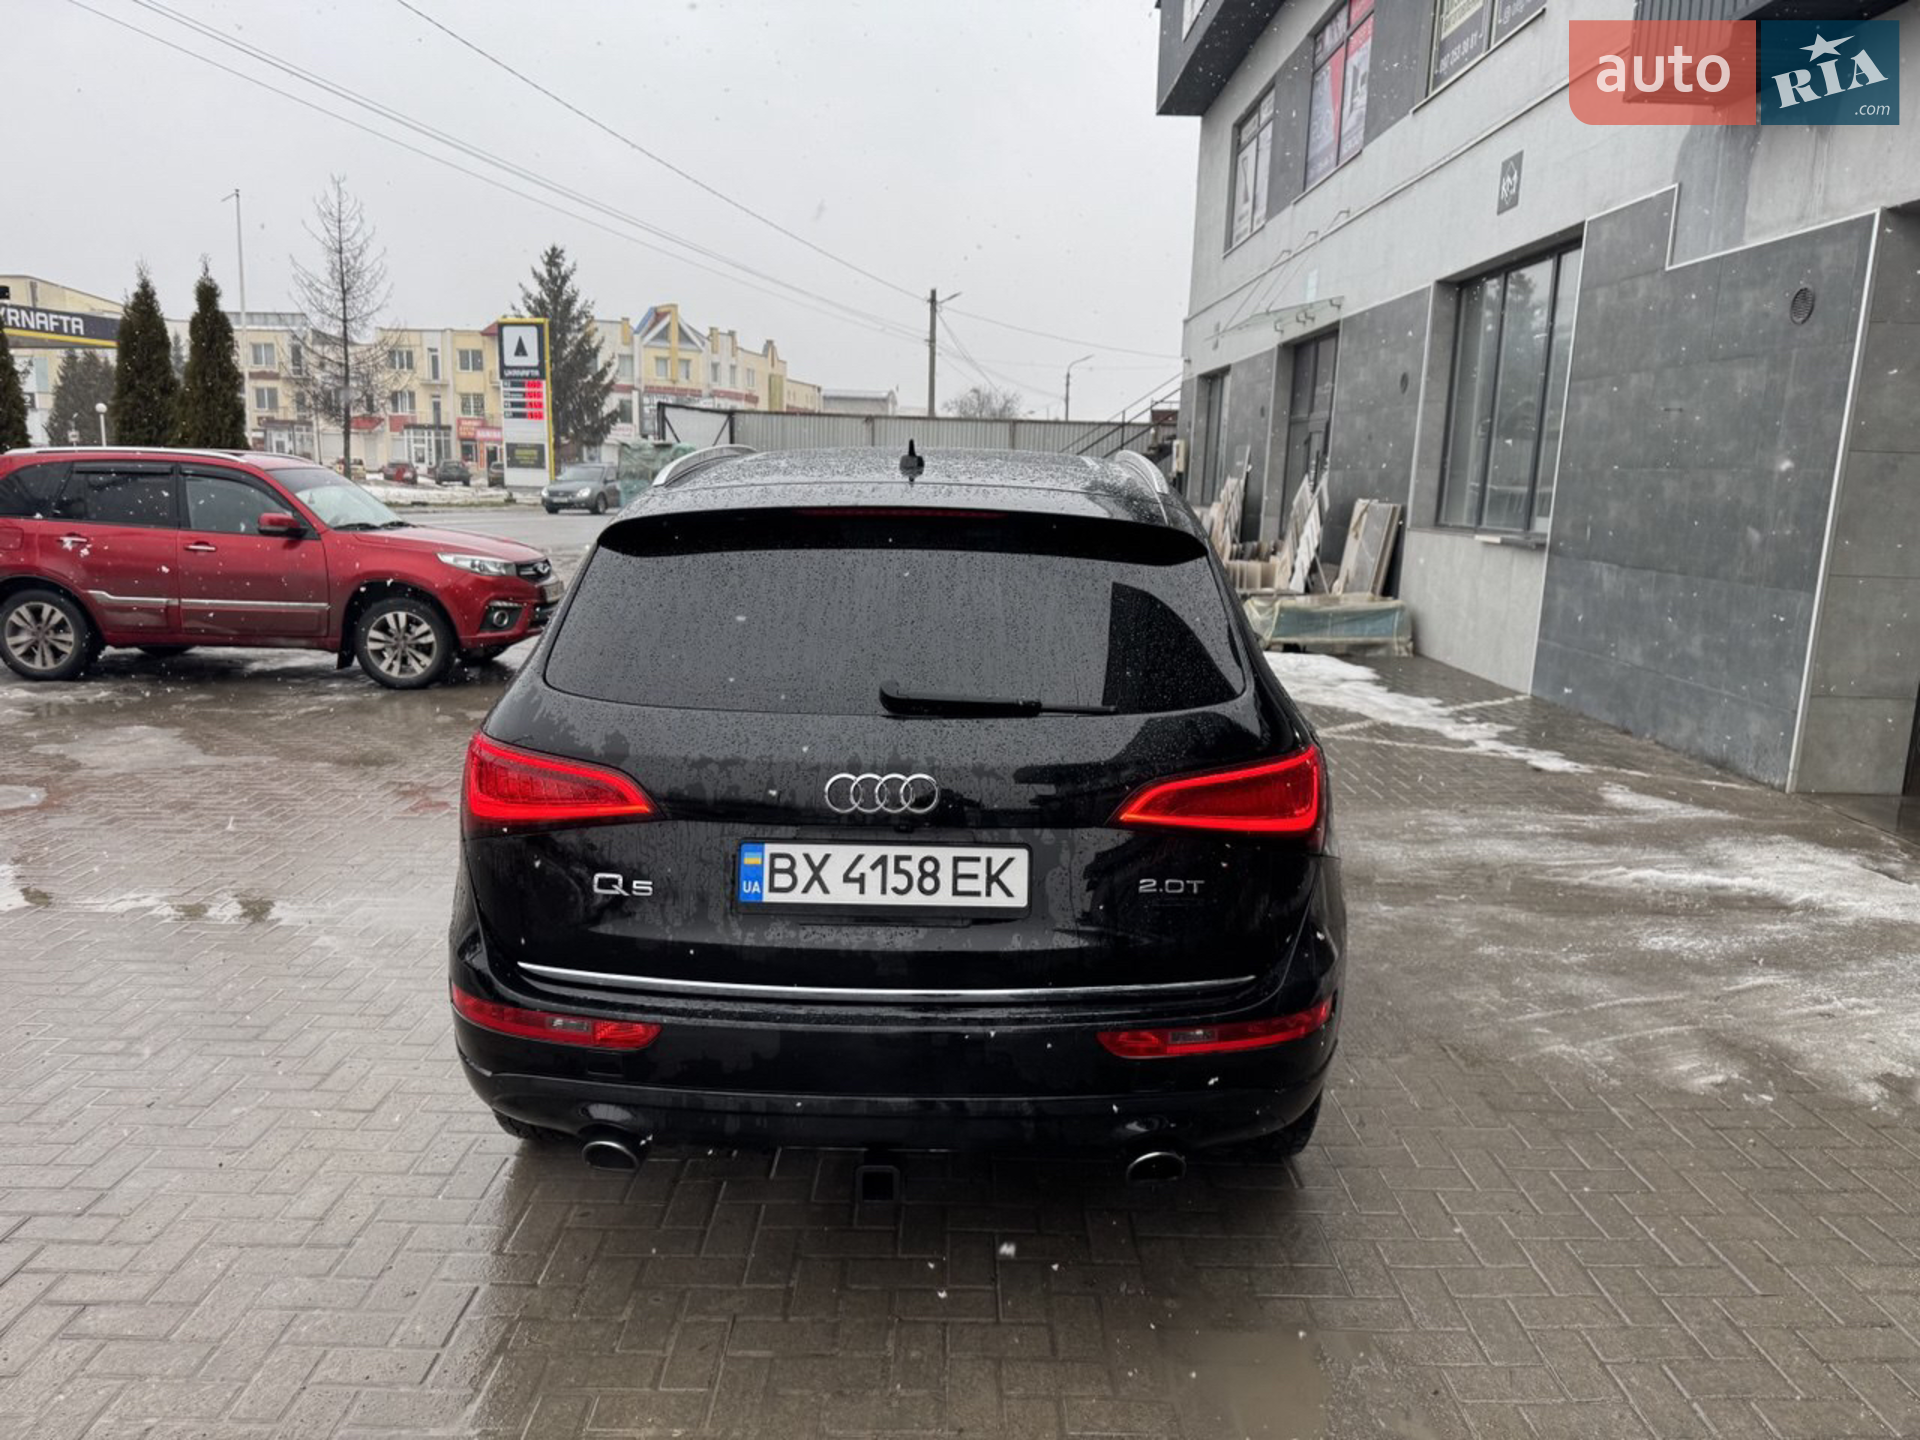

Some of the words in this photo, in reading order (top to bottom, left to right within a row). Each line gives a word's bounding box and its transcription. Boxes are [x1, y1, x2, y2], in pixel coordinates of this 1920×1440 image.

[593, 872, 654, 896] Q5
[768, 853, 832, 894] BX
[842, 854, 941, 896] 4158
[952, 856, 1016, 898] EK
[743, 880, 761, 893] UA
[1139, 878, 1205, 895] 2.0T
